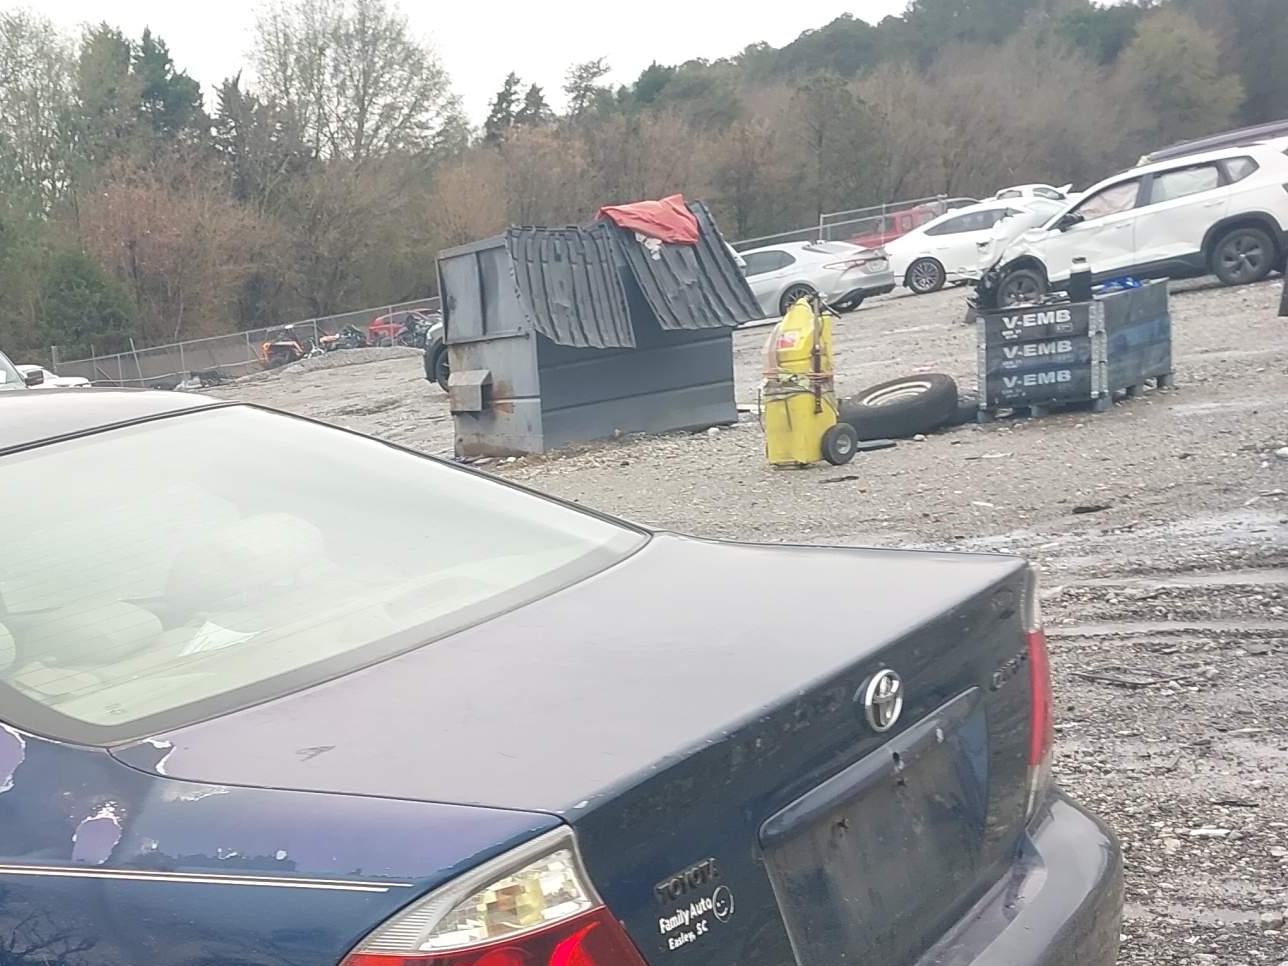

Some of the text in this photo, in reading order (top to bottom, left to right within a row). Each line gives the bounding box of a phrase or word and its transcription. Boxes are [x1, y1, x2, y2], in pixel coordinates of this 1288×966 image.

[1002, 309, 1072, 329] V-EMB
[1002, 340, 1073, 359] V-EMB
[1002, 370, 1072, 388] V-EMB
[659, 897, 713, 934] Family Auto
[696, 919, 709, 936] SC
